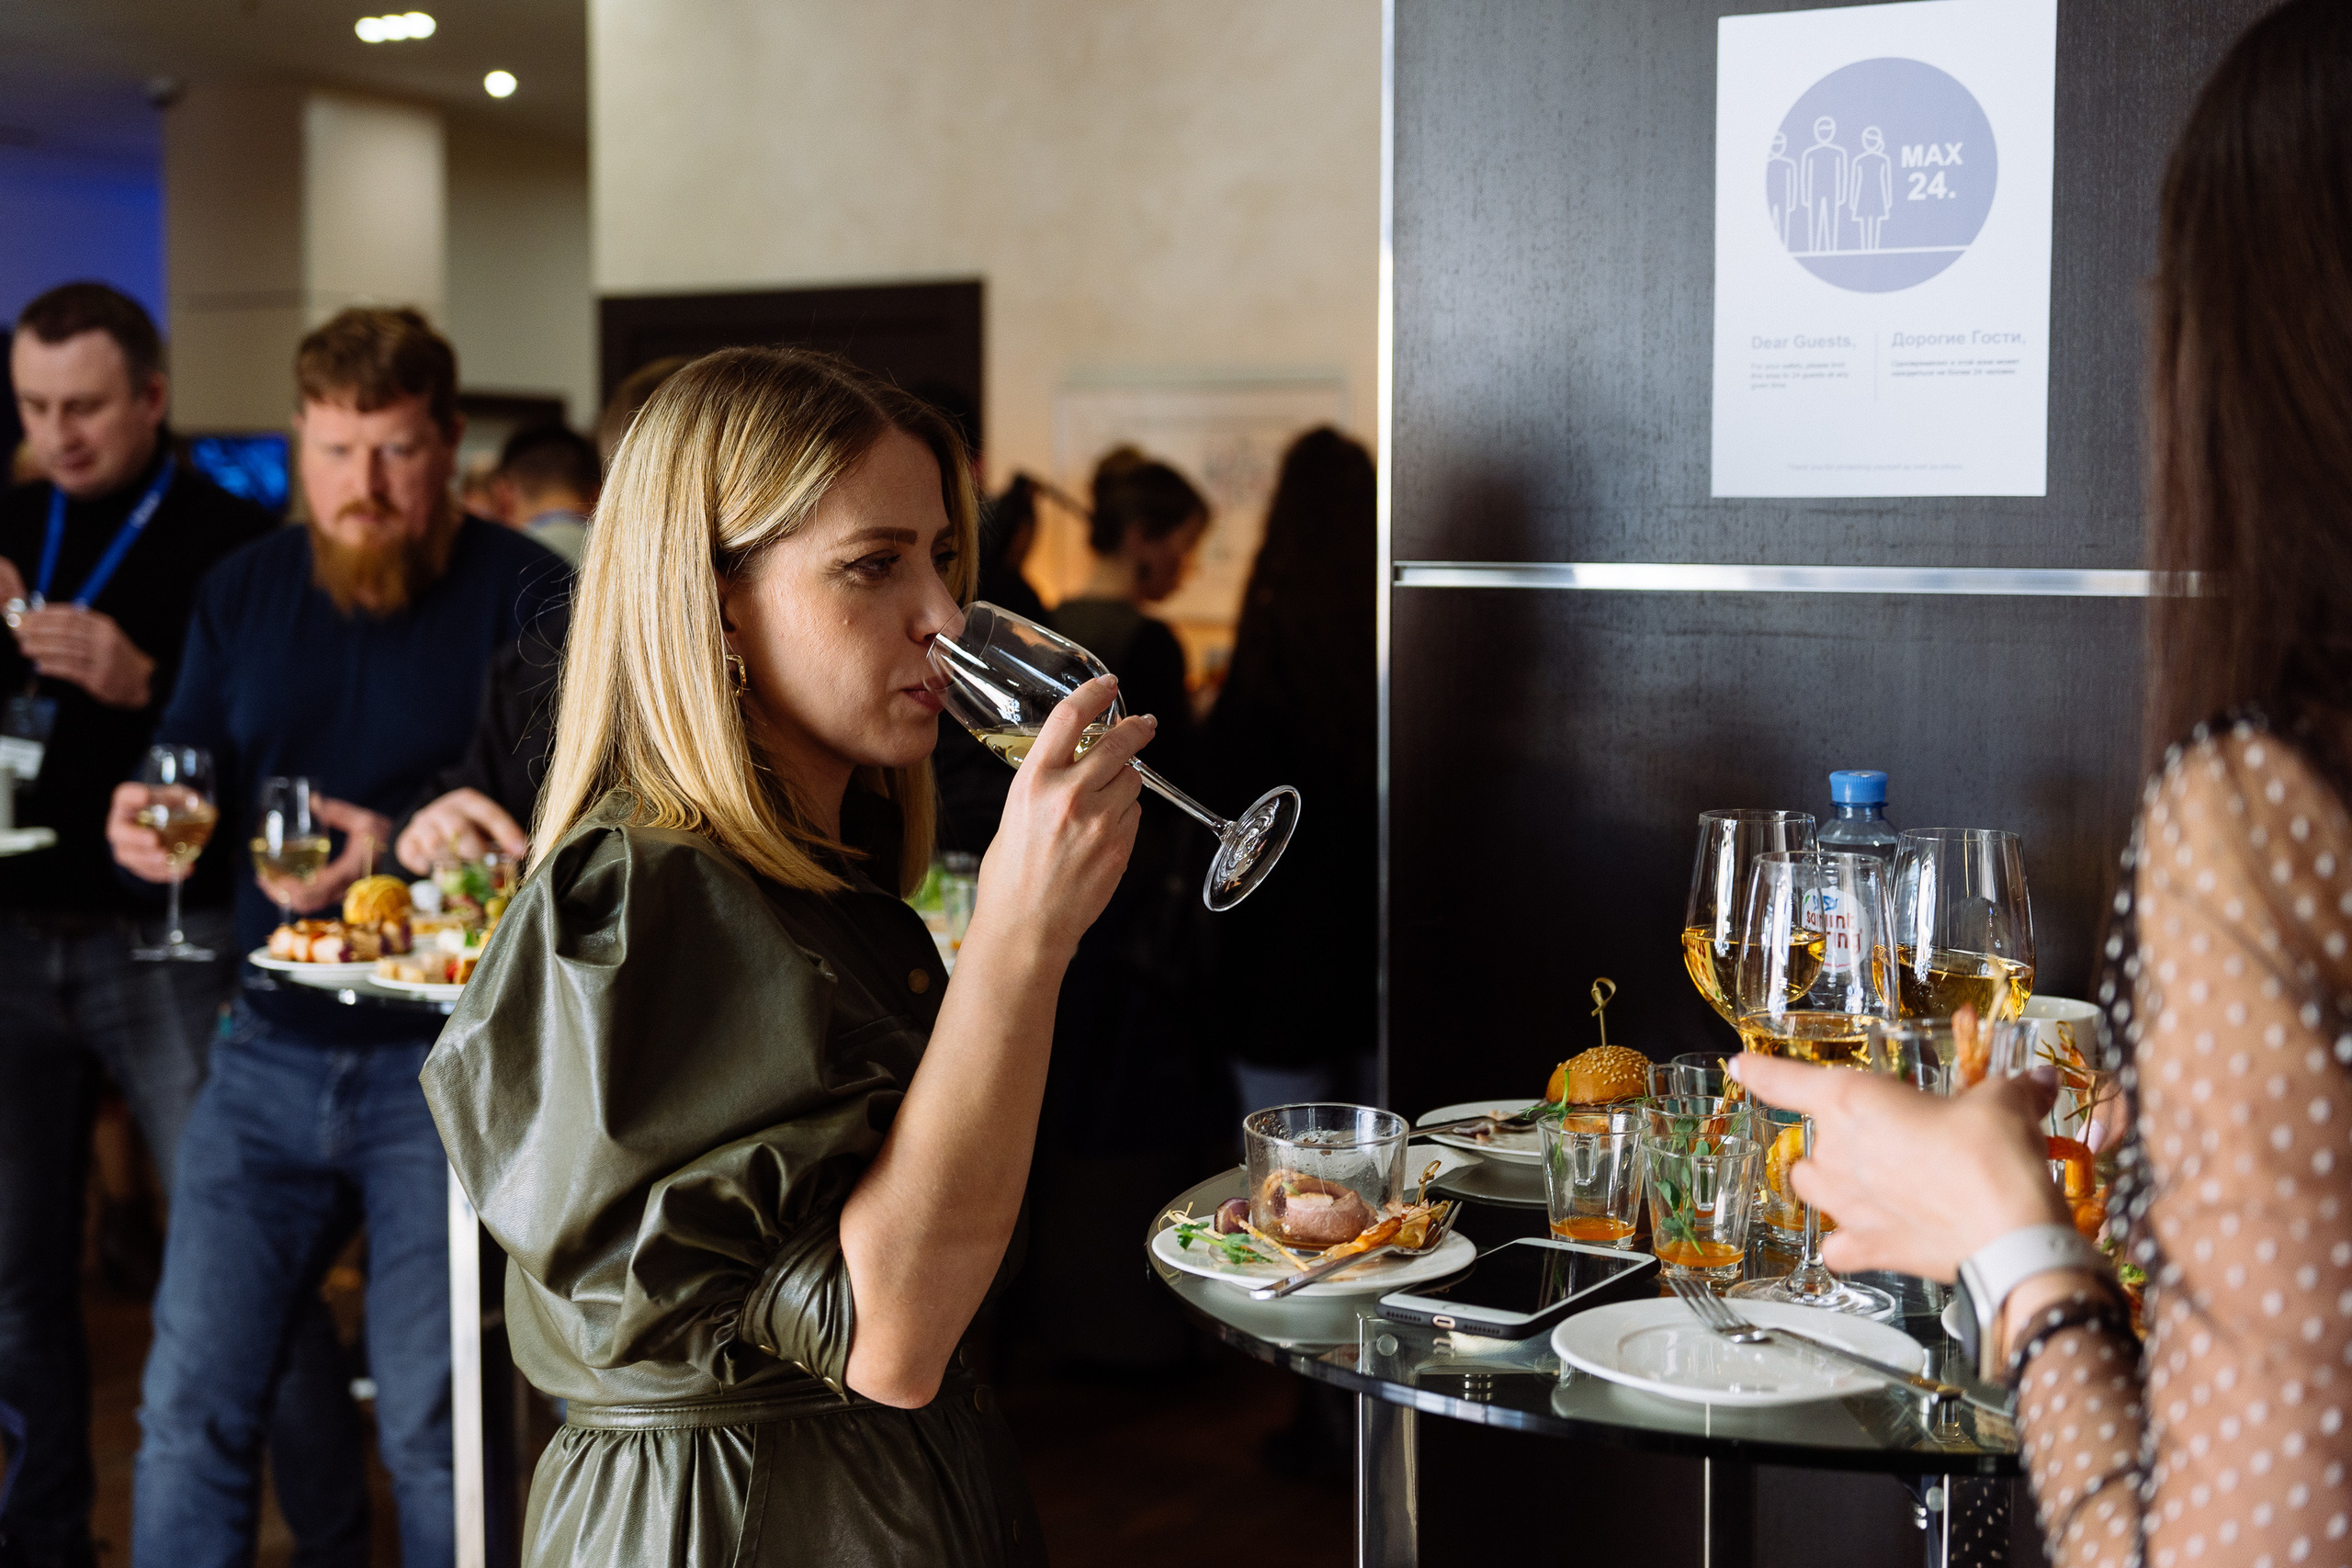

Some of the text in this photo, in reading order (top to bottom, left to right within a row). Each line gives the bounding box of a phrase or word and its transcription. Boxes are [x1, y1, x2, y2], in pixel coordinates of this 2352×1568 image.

[1901, 141, 1963, 168] MAX
[1907, 170, 1956, 200] 24.
[1751, 333, 1857, 350] Dear Guests,
[1891, 331, 1966, 348] Дорогие
